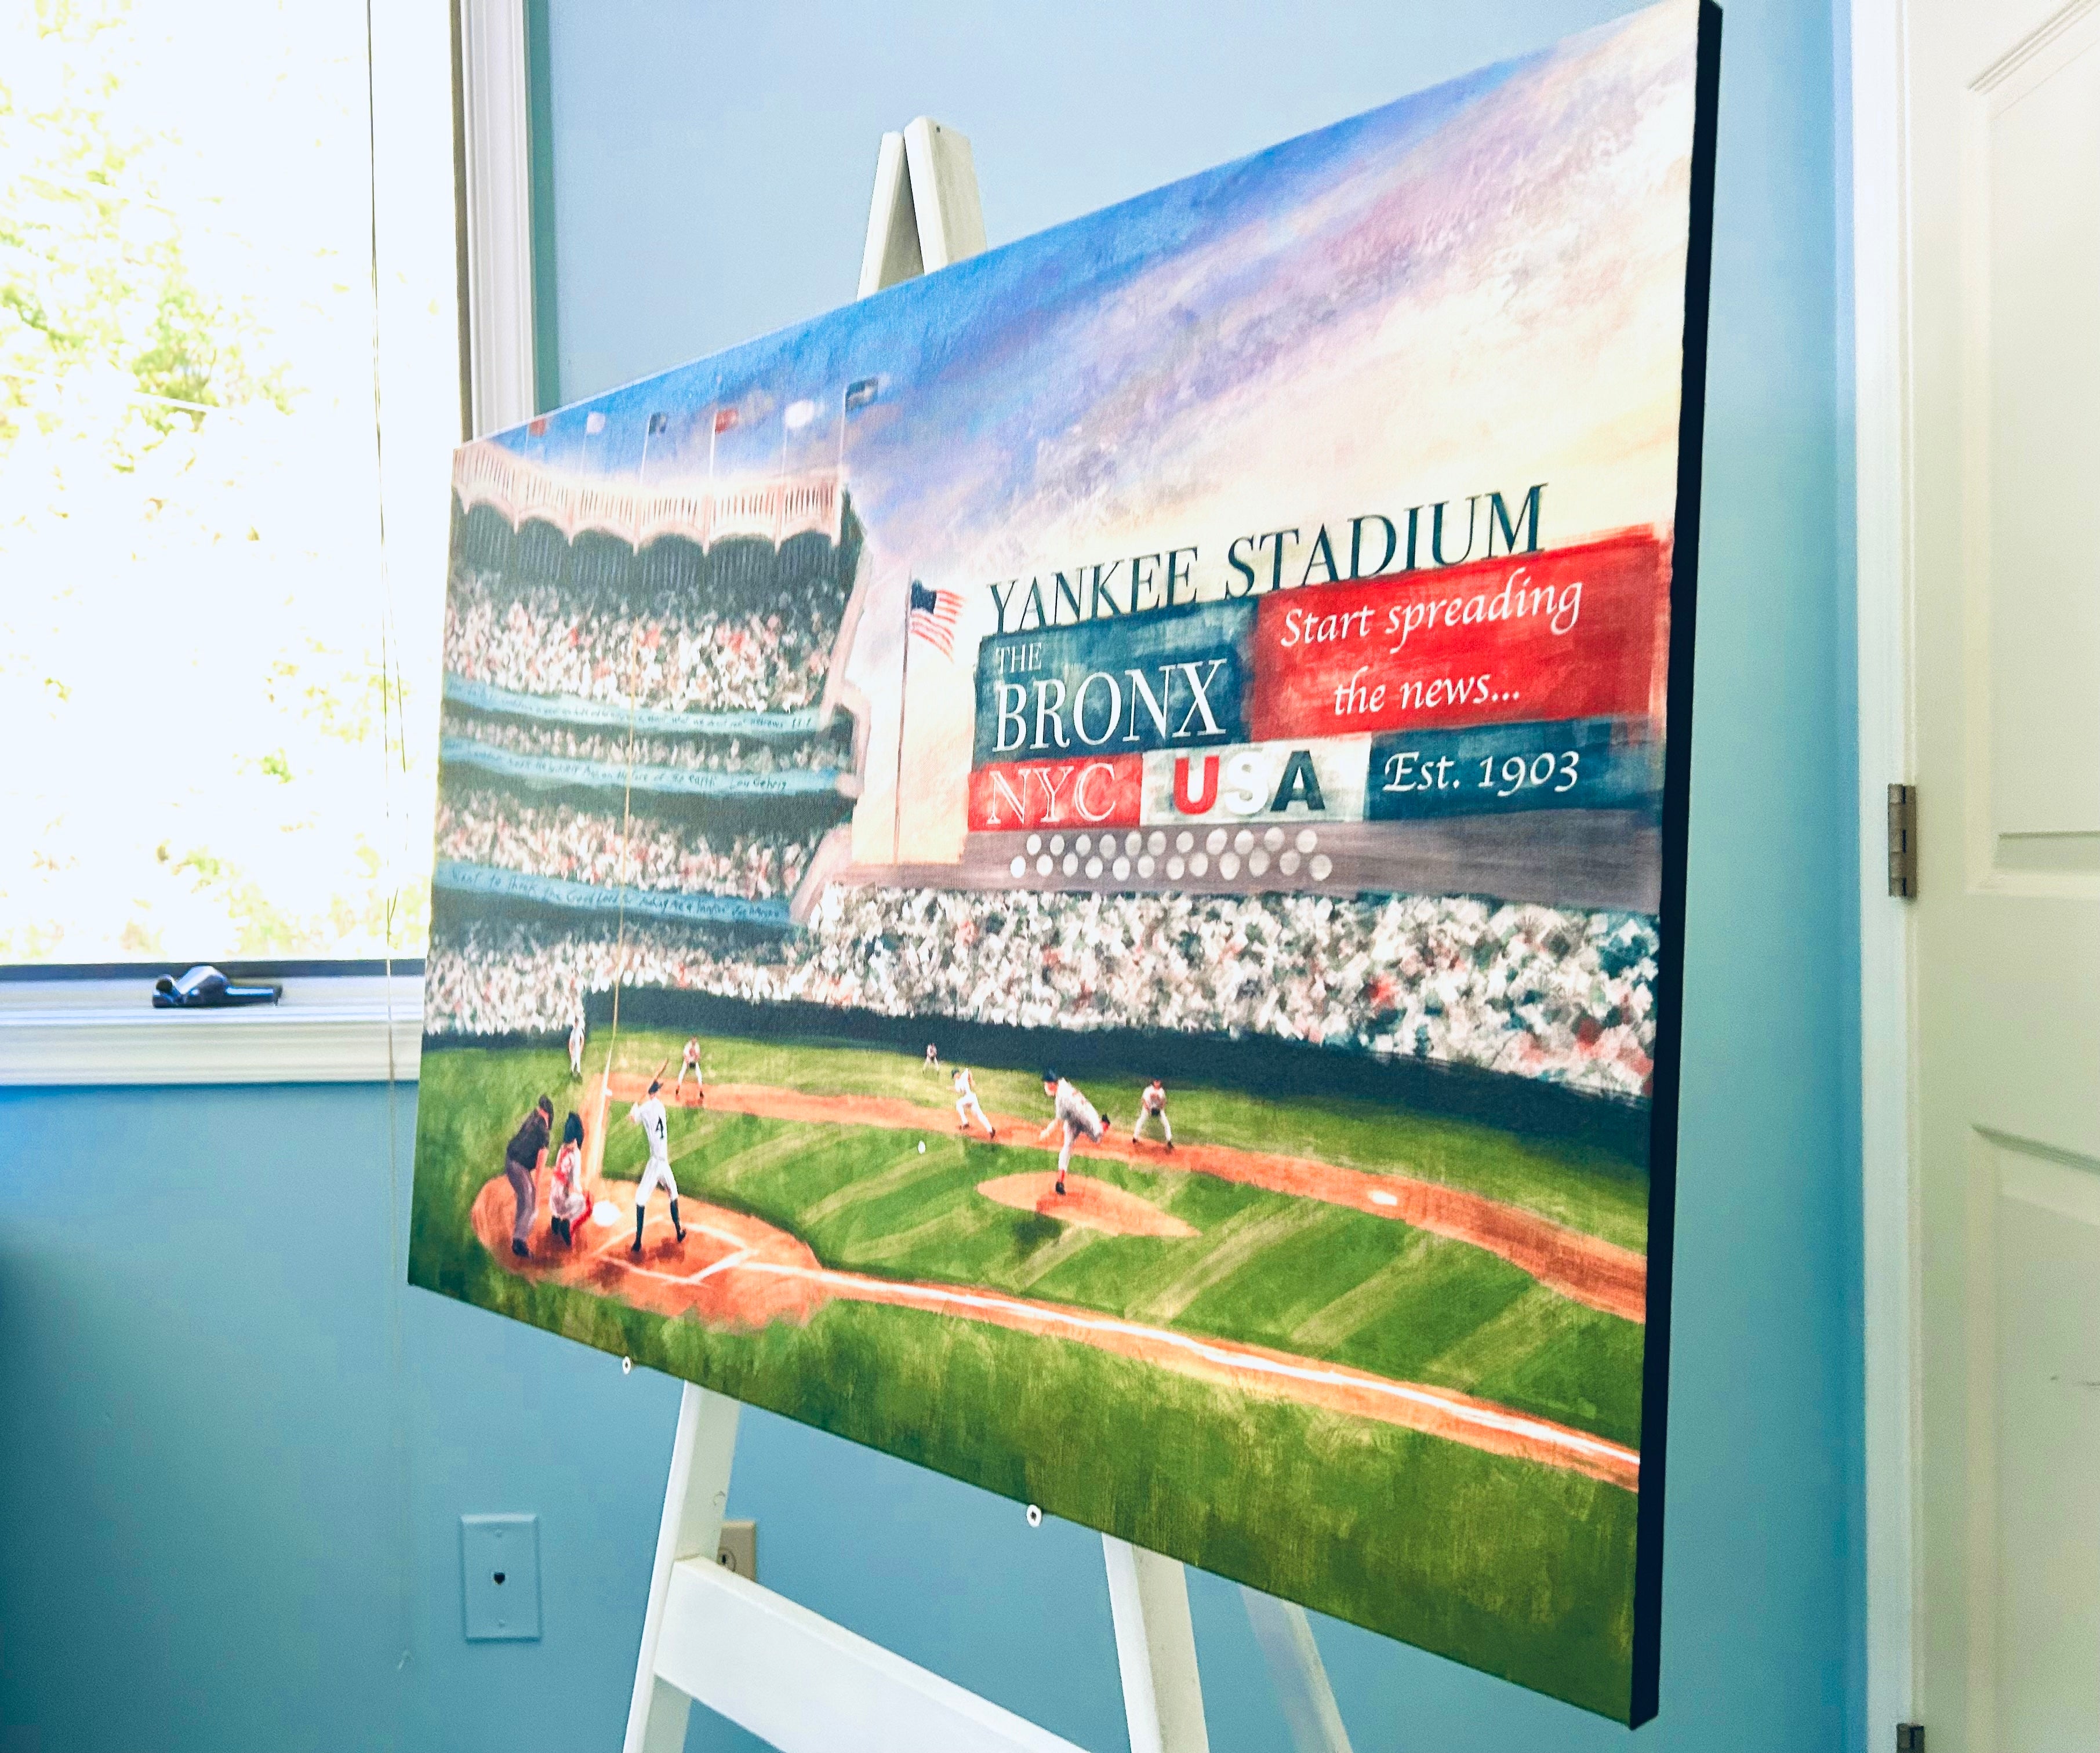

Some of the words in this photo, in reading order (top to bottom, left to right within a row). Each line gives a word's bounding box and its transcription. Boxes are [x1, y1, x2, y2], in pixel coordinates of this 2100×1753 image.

[988, 547, 1198, 634] YANKEE
[1225, 483, 1548, 598] STADIUM
[1281, 605, 1374, 648] Start
[1386, 568, 1584, 653] spreading
[996, 643, 1042, 674] THE
[1335, 667, 1386, 715] the
[1401, 674, 1521, 708] news...
[993, 660, 1227, 752] BRONX
[989, 763, 1116, 824] NYC
[1174, 750, 1326, 814] USA
[1382, 752, 1460, 793] Est.
[1479, 751, 1581, 795] 1903
